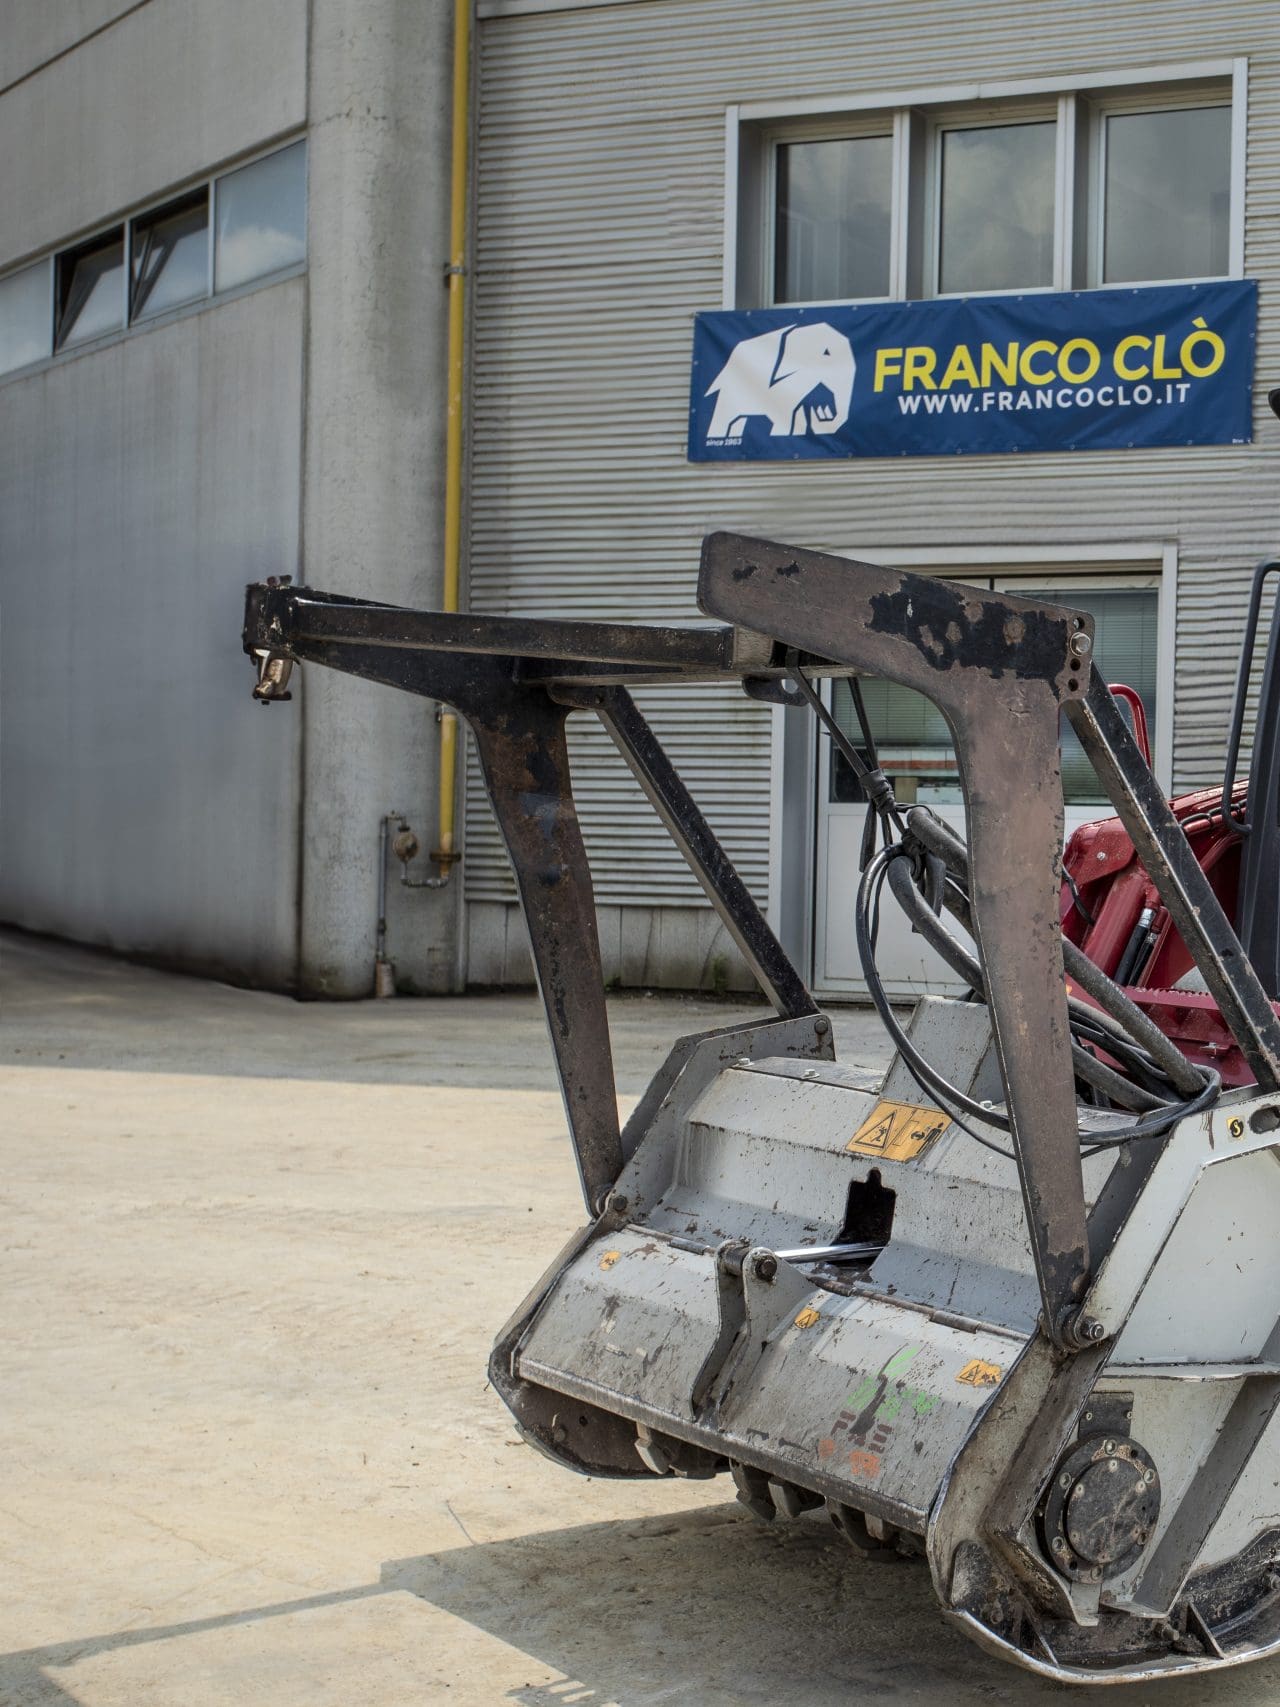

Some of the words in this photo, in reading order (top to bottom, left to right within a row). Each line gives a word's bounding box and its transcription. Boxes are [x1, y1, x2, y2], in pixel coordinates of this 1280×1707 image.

[873, 338, 1101, 393] FRANCO
[1114, 317, 1226, 382] CLÒ
[898, 383, 1191, 415] WWW.FRANCOCLO.IT
